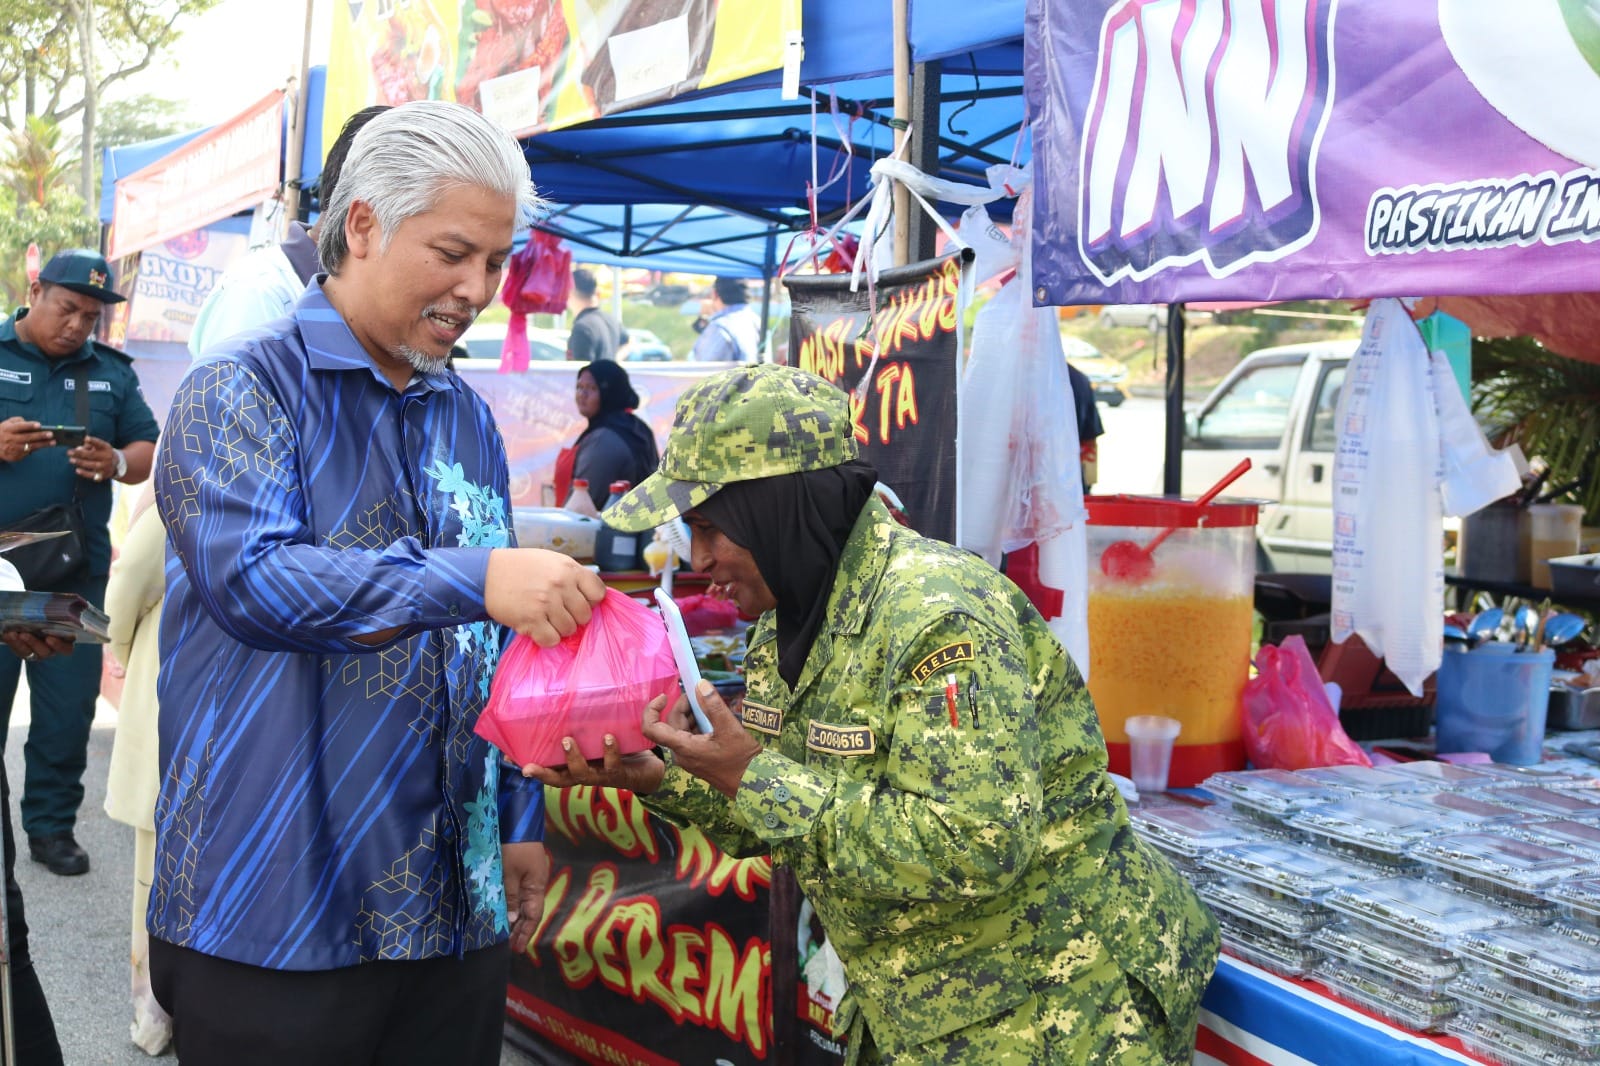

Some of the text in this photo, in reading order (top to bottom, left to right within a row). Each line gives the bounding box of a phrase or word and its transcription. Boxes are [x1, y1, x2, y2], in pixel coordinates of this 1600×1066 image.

[1369, 183, 1553, 248] PASTIKAN
[919, 645, 966, 677] RELA
[554, 866, 772, 1055] BEREM
